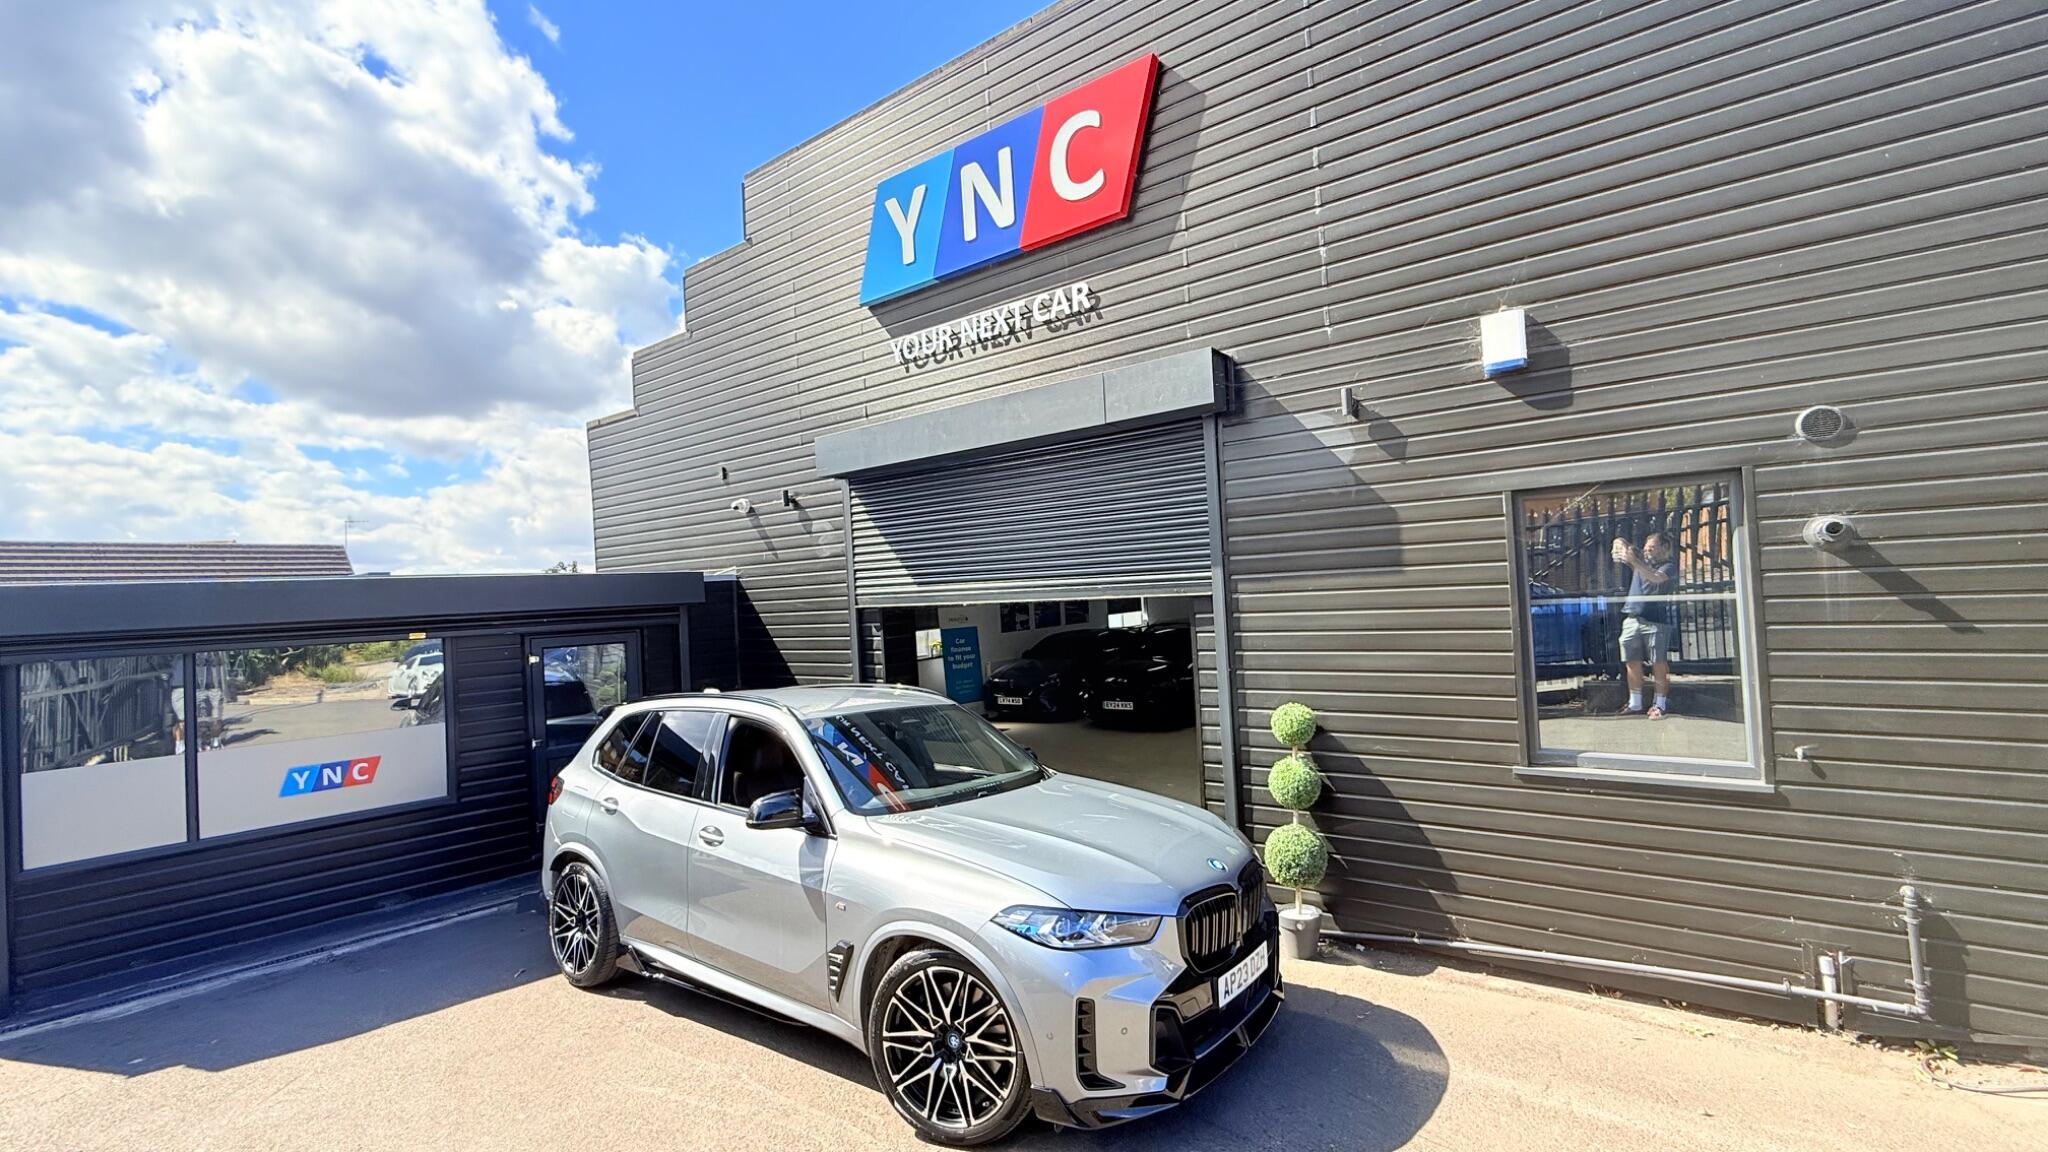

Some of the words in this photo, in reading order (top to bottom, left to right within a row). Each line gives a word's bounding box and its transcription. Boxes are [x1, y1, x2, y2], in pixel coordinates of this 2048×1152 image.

[884, 110, 1105, 265] YNC
[890, 324, 957, 364] YOUR
[960, 301, 1026, 346] NEXT
[1032, 281, 1094, 323] CAR
[963, 653, 976, 661] your
[292, 762, 369, 790] YNC
[1223, 961, 1250, 1000] AP23
[1249, 946, 1266, 978] DZH
